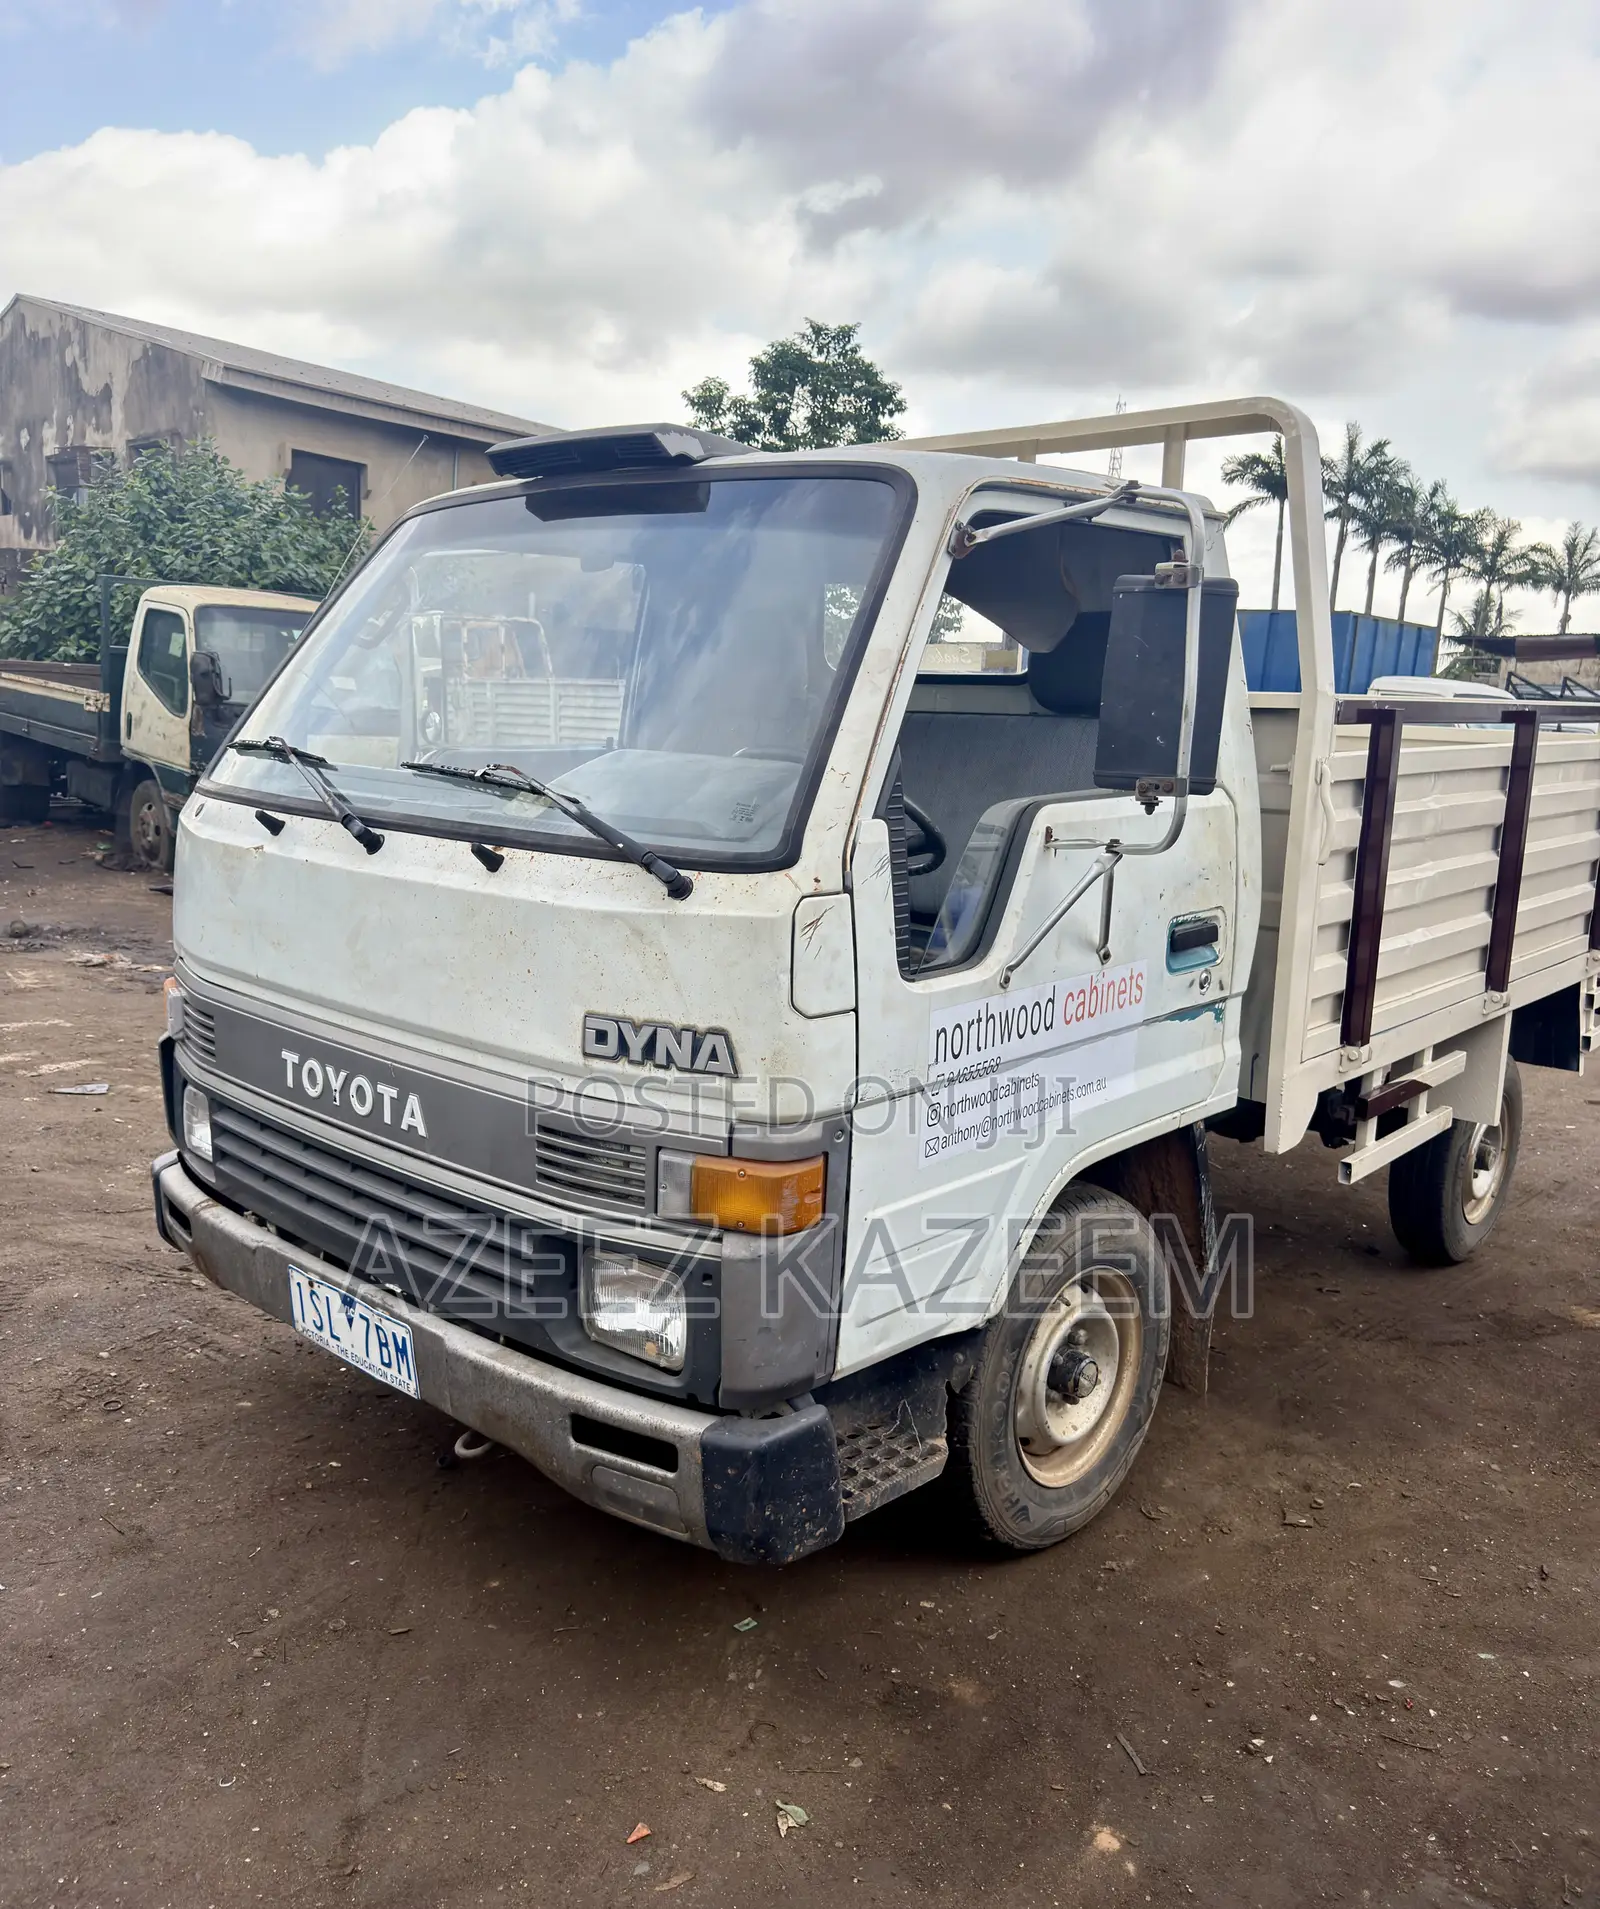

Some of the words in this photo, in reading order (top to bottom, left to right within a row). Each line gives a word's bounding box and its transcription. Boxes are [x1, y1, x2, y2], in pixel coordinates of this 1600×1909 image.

[583, 1012, 739, 1079] DYNA
[934, 985, 1056, 1066] northwood
[1063, 967, 1144, 1026] cabinets
[281, 1050, 429, 1138] TOYOTA
[941, 1077, 1107, 1150] anthony@northwoodcabinets.com.au
[942, 1072, 1040, 1120] northwoodcabinets
[336, 1345, 350, 1358] THE
[351, 1351, 388, 1381] EDUCATION
[390, 1375, 411, 1393] STATE
